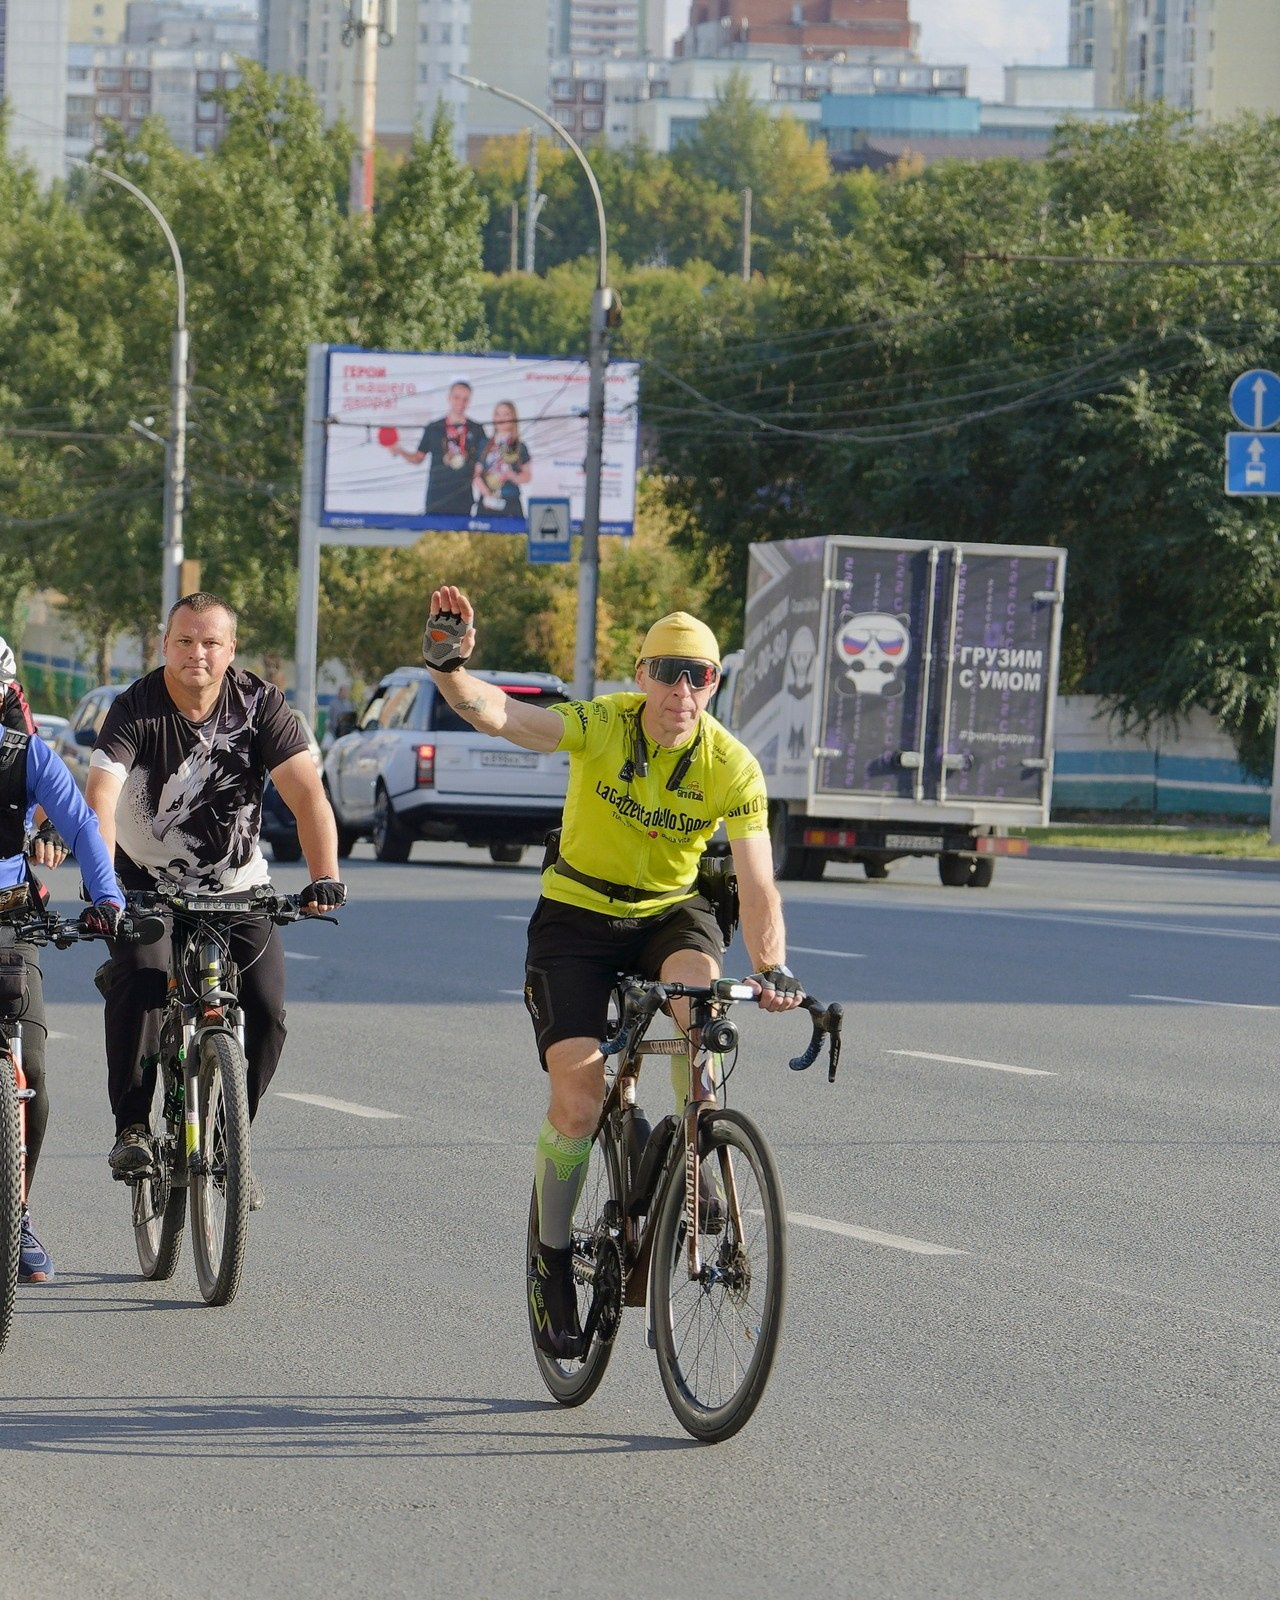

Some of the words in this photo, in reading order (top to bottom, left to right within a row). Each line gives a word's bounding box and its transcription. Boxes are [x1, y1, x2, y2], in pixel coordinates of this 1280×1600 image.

[344, 365, 386, 378] ГЕРОИ
[959, 646, 1043, 670] ГРУЗИМ
[958, 669, 974, 689] С
[979, 669, 1042, 692] УМОМ
[685, 1141, 696, 1238] SPECIALIZED
